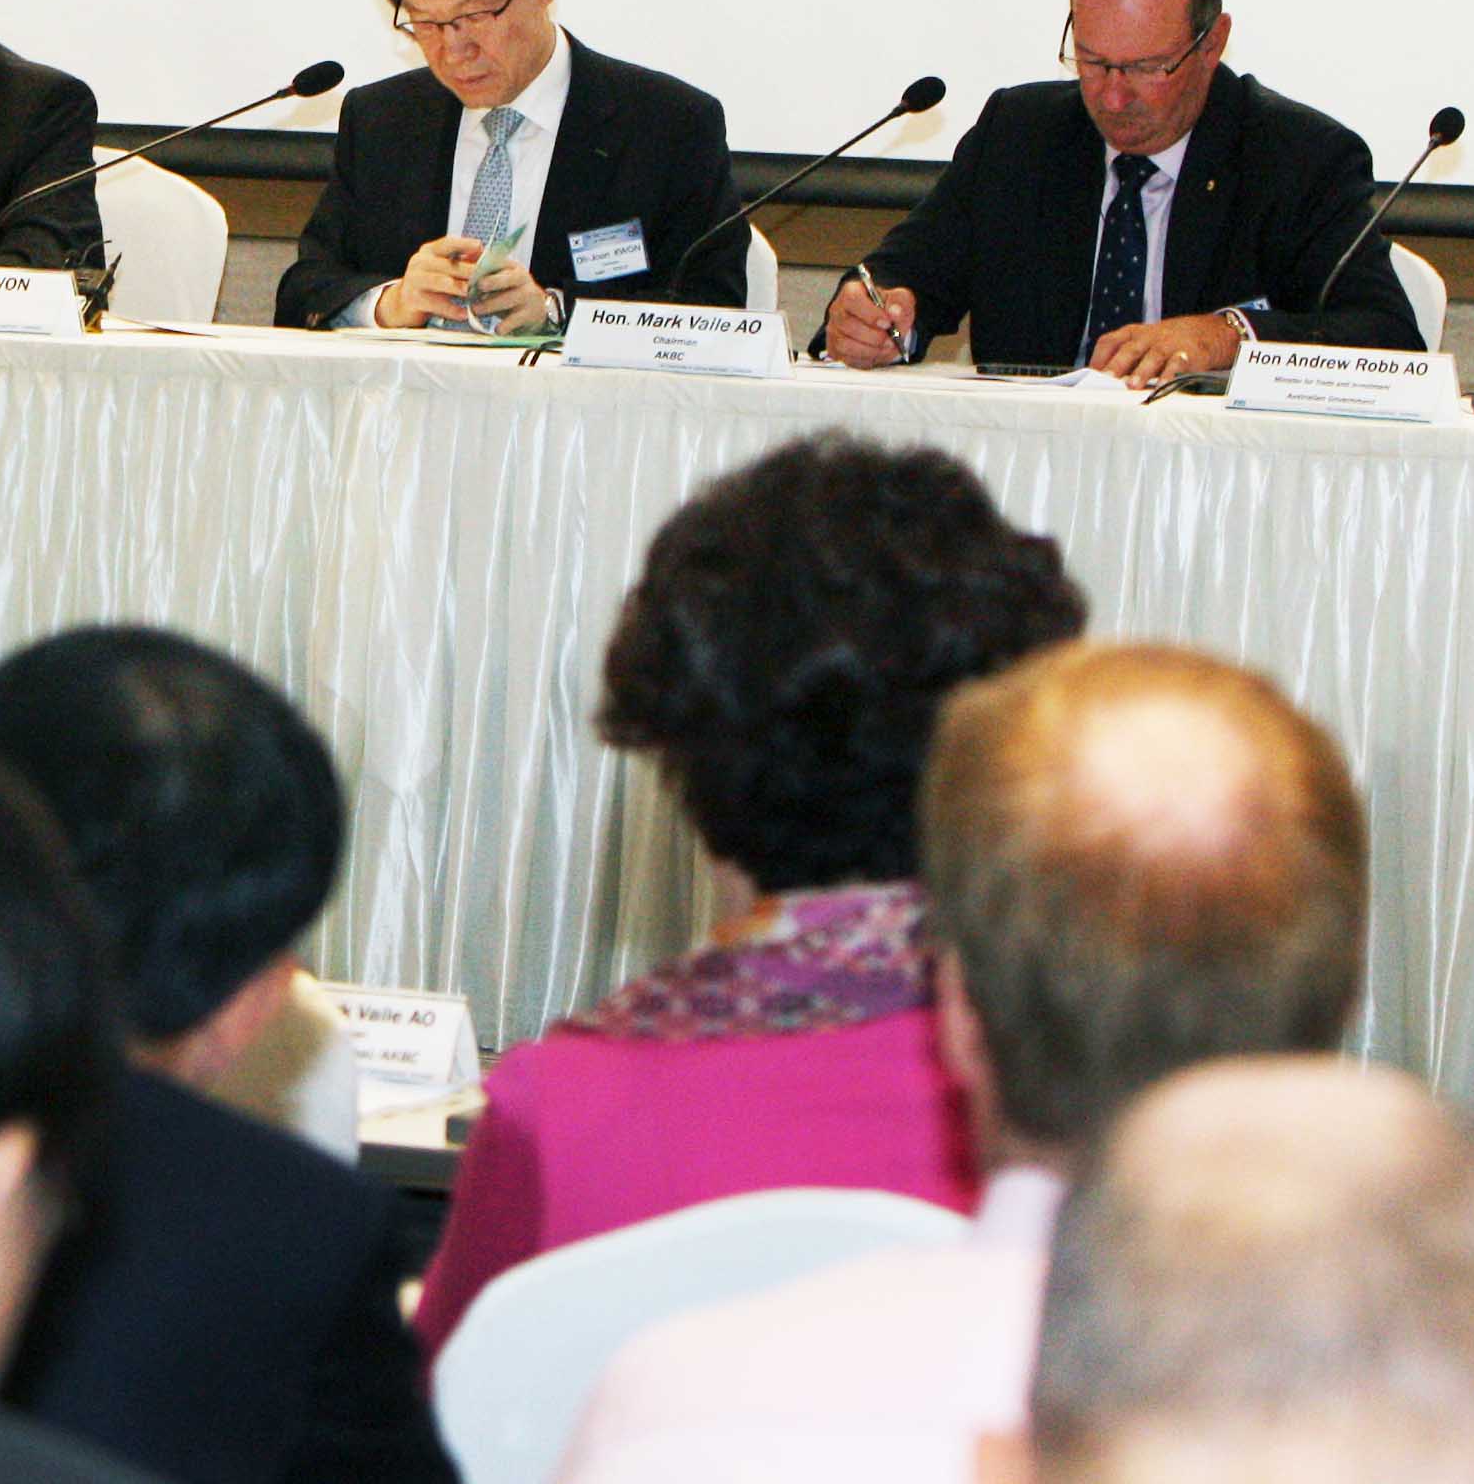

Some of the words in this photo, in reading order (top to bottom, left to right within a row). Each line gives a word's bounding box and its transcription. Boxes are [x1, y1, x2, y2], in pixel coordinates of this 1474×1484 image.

[591, 309, 630, 326] Hon.
[636, 312, 681, 329] Mark
[689, 315, 731, 333] Vaile
[734, 319, 762, 334] AO
[653, 335, 698, 348] Chairman
[1248, 350, 1282, 367] Hon
[1286, 352, 1350, 371] Andrew
[1355, 357, 1399, 375] Robb
[1403, 361, 1429, 376] AO
